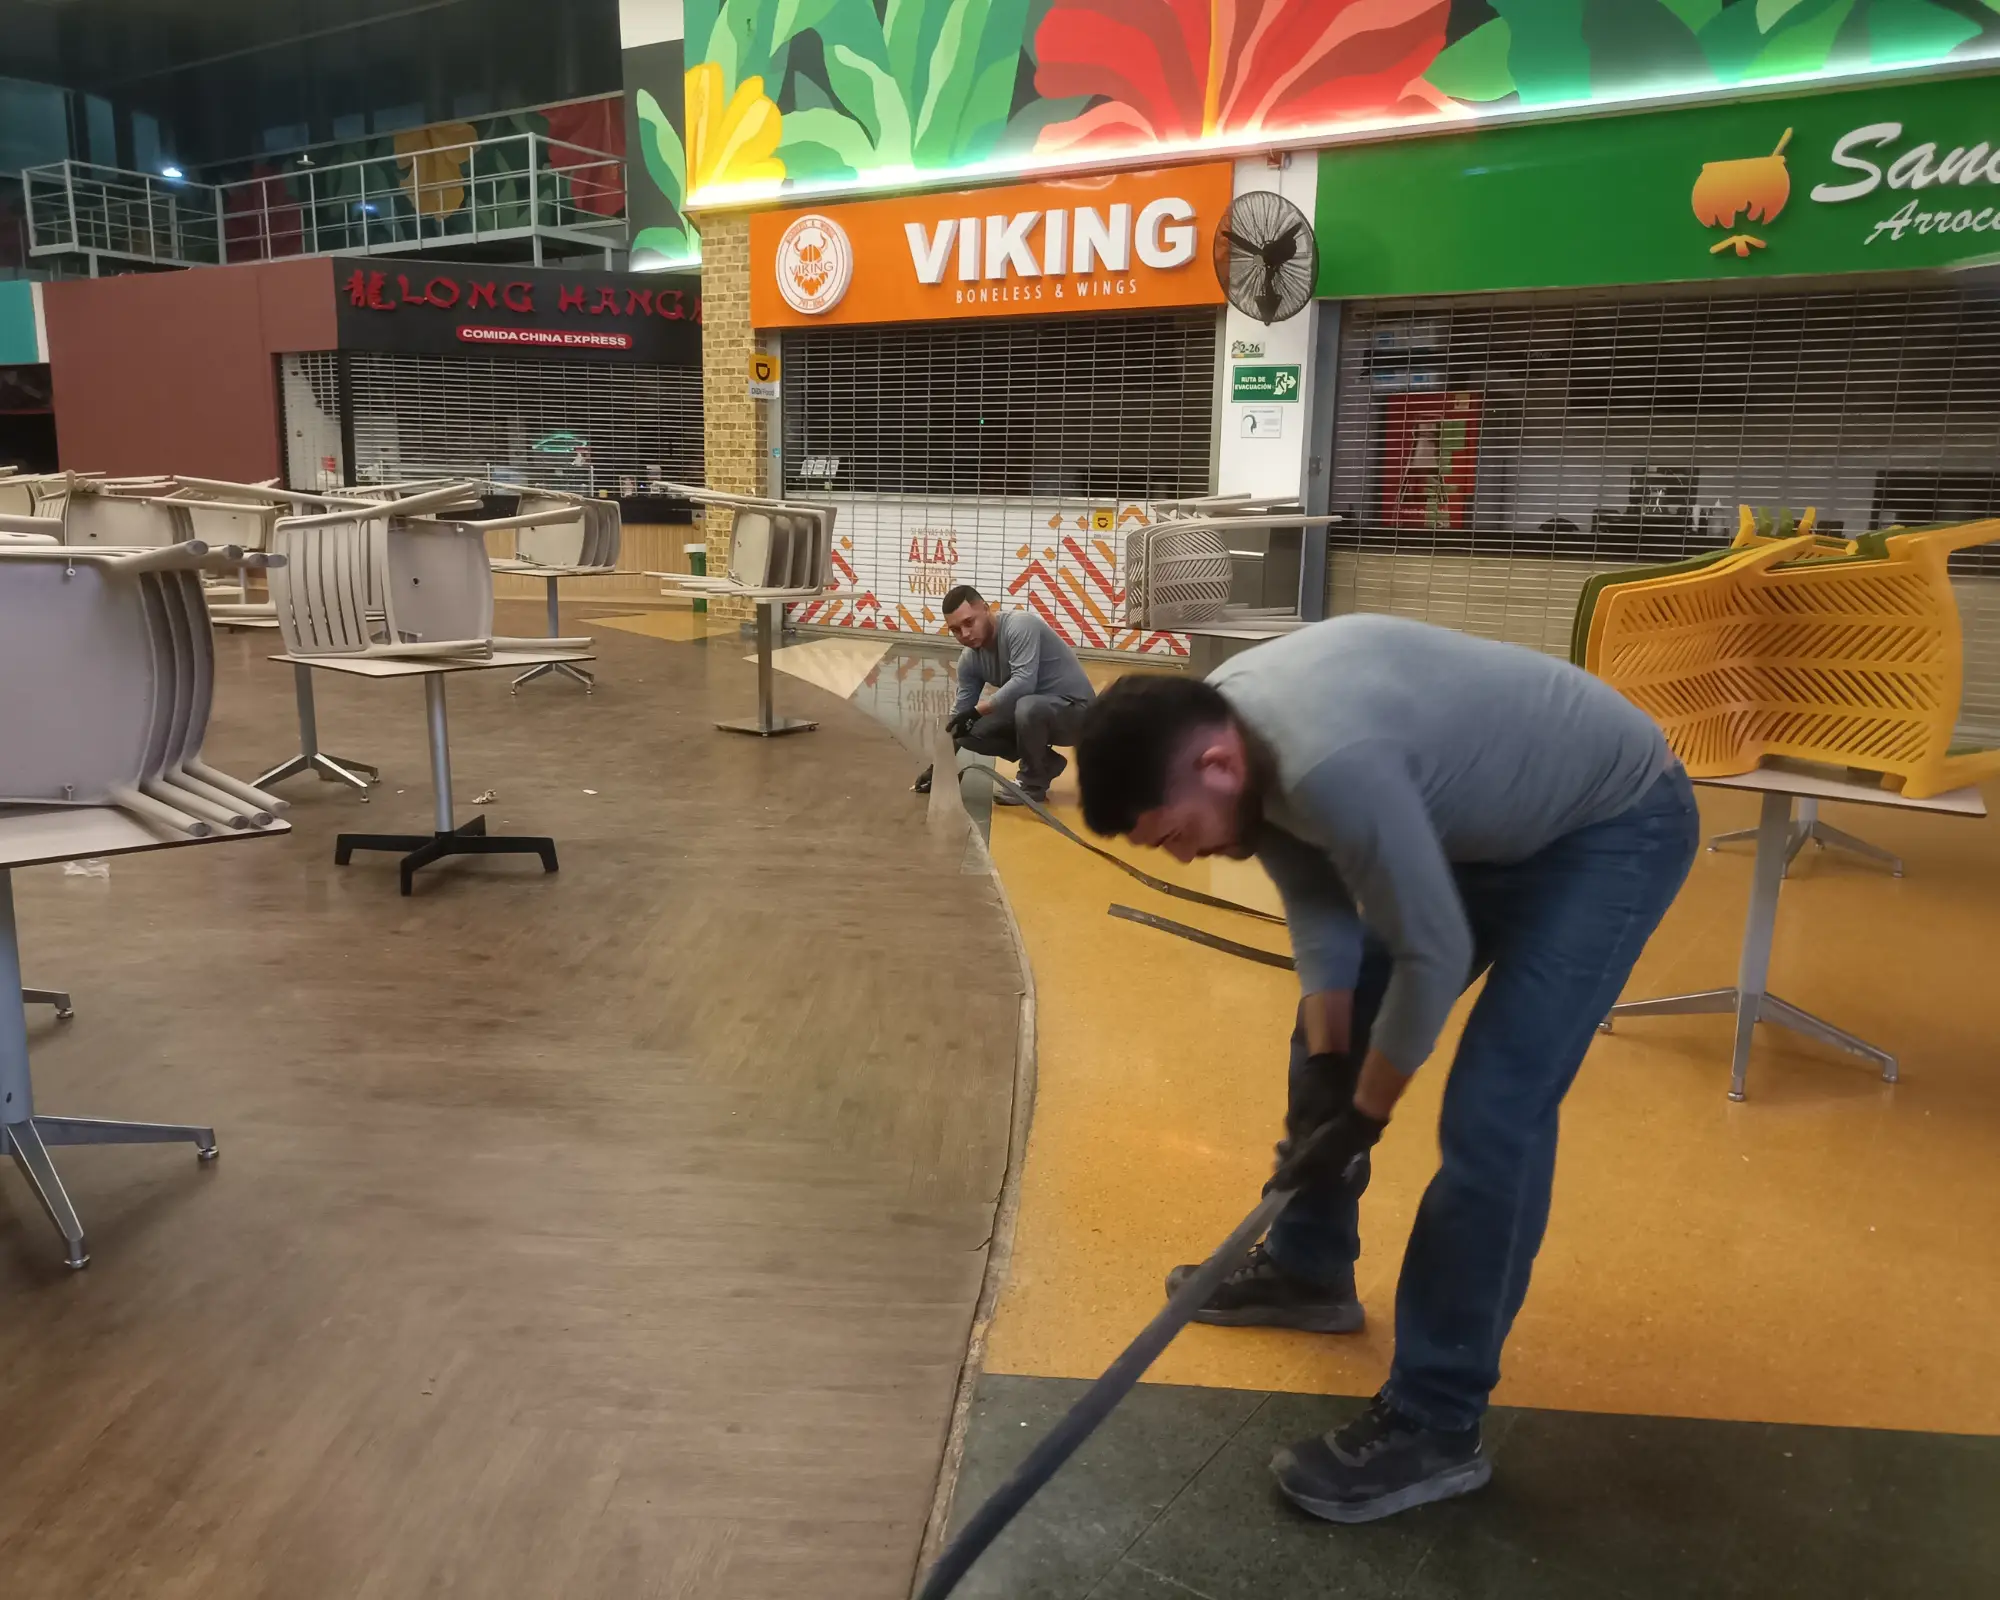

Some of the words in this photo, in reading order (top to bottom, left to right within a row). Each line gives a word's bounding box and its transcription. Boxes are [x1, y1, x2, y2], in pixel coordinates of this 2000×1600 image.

[903, 197, 1198, 283] VIKING
[789, 261, 834, 277] VIKING
[397, 274, 535, 312] LONG
[956, 285, 1042, 303] BONELESS
[1055, 283, 1064, 298] &
[1077, 279, 1137, 297] WINGS
[462, 329, 517, 341] COMIDA
[519, 332, 563, 343] CHINA
[564, 335, 627, 346] EXPRESS
[1235, 382, 1271, 390] EVACUACIÓN
[908, 535, 959, 565] ALAS
